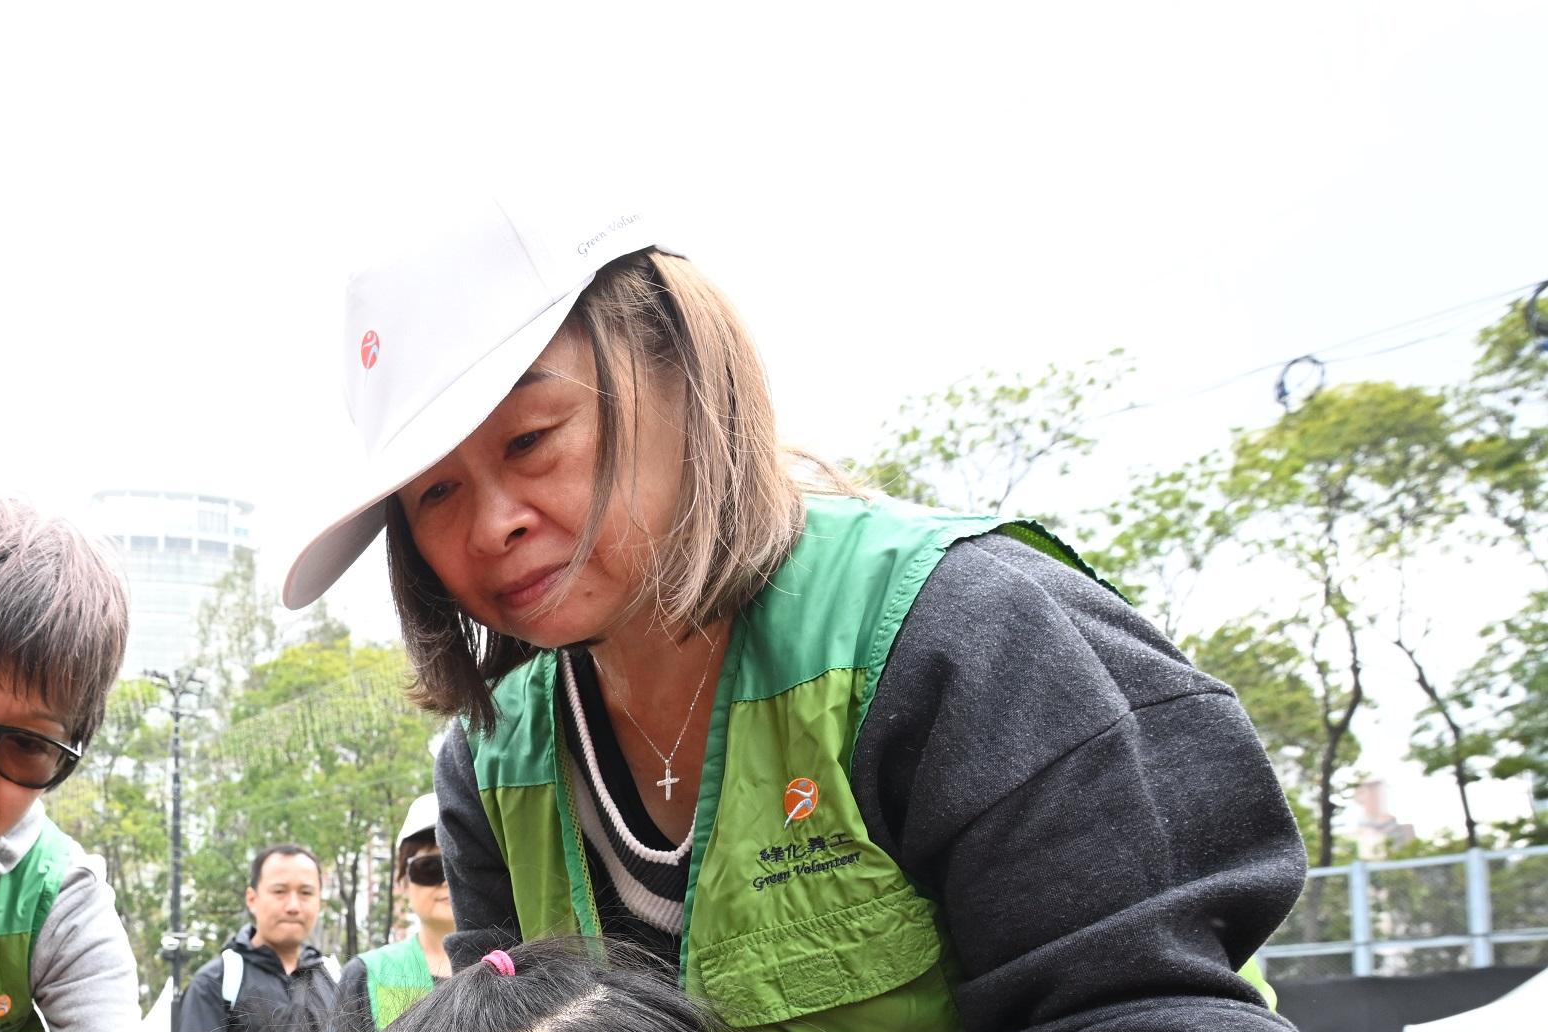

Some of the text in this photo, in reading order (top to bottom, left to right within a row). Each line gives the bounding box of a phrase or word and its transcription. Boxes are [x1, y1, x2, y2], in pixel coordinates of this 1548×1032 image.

[577, 231, 607, 258] Green
[752, 851, 862, 891] Green Volunteer
